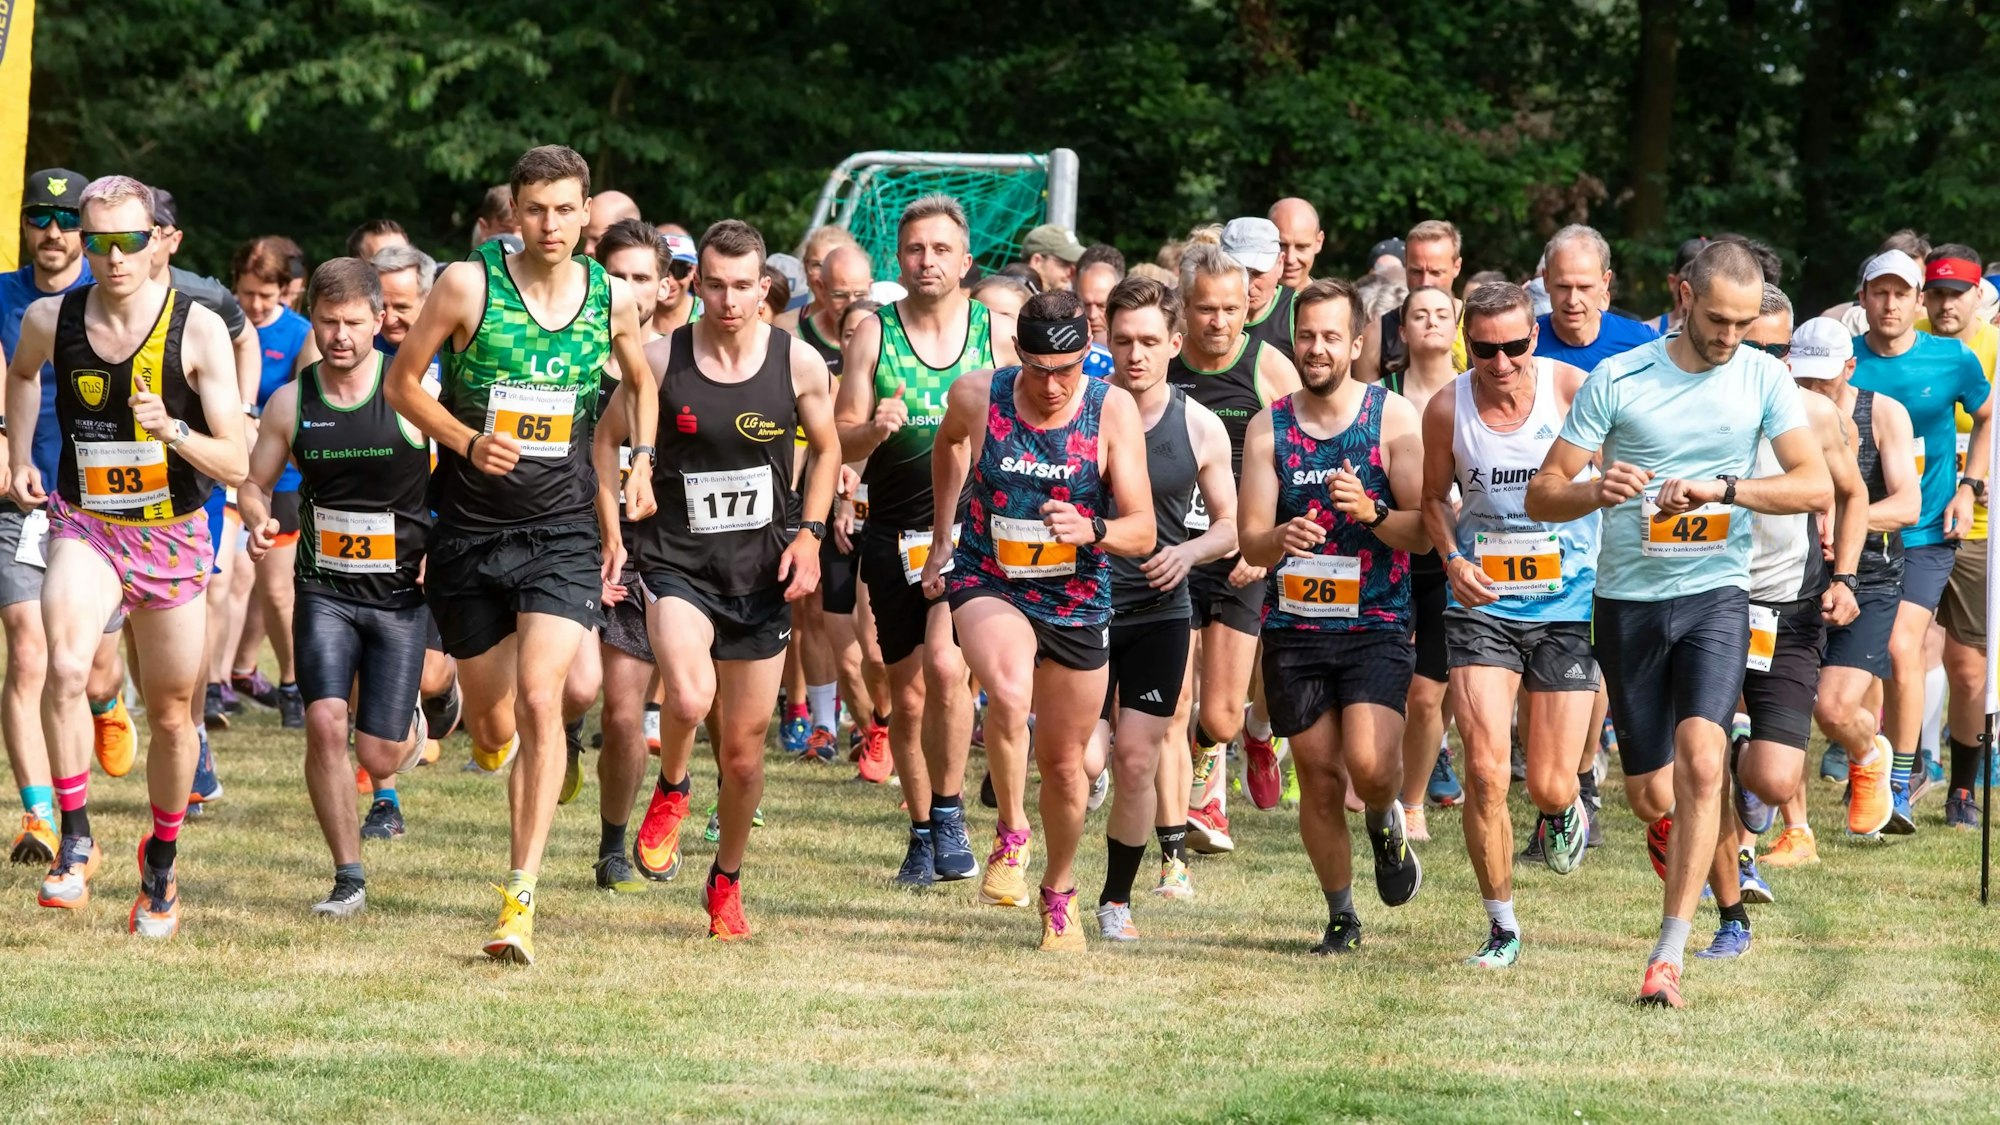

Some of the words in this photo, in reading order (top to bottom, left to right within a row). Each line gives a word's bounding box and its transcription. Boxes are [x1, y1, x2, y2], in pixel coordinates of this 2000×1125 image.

[530, 354, 565, 379] LC
[81, 381, 102, 394] TuS
[743, 416, 759, 429] LG
[758, 420, 776, 428] Kreis
[1210, 407, 1248, 418] irchen
[516, 414, 553, 442] 65
[89, 447, 117, 456] VR-Bank
[117, 447, 146, 455] Nordeifel
[304, 449, 319, 460] LC
[322, 447, 394, 459] Euskirchen
[1000, 456, 1077, 480] SAYSKY
[1292, 464, 1361, 486] SAYSY
[1491, 467, 1539, 486] bune
[106, 467, 144, 494] 93
[700, 476, 727, 484] VR-Bank
[727, 474, 755, 482] Nordeifel
[1503, 484, 1524, 493] Kölner
[703, 489, 758, 519] 177
[1672, 516, 1708, 542] 42
[338, 534, 372, 560] 23
[1027, 543, 1045, 566] 7
[1648, 543, 1723, 554] www.vr-banknordeifel.de
[1503, 556, 1538, 581] 16
[1302, 578, 1337, 604] 26
[1564, 672, 1586, 680] adidas
[1162, 831, 1186, 843] cep
